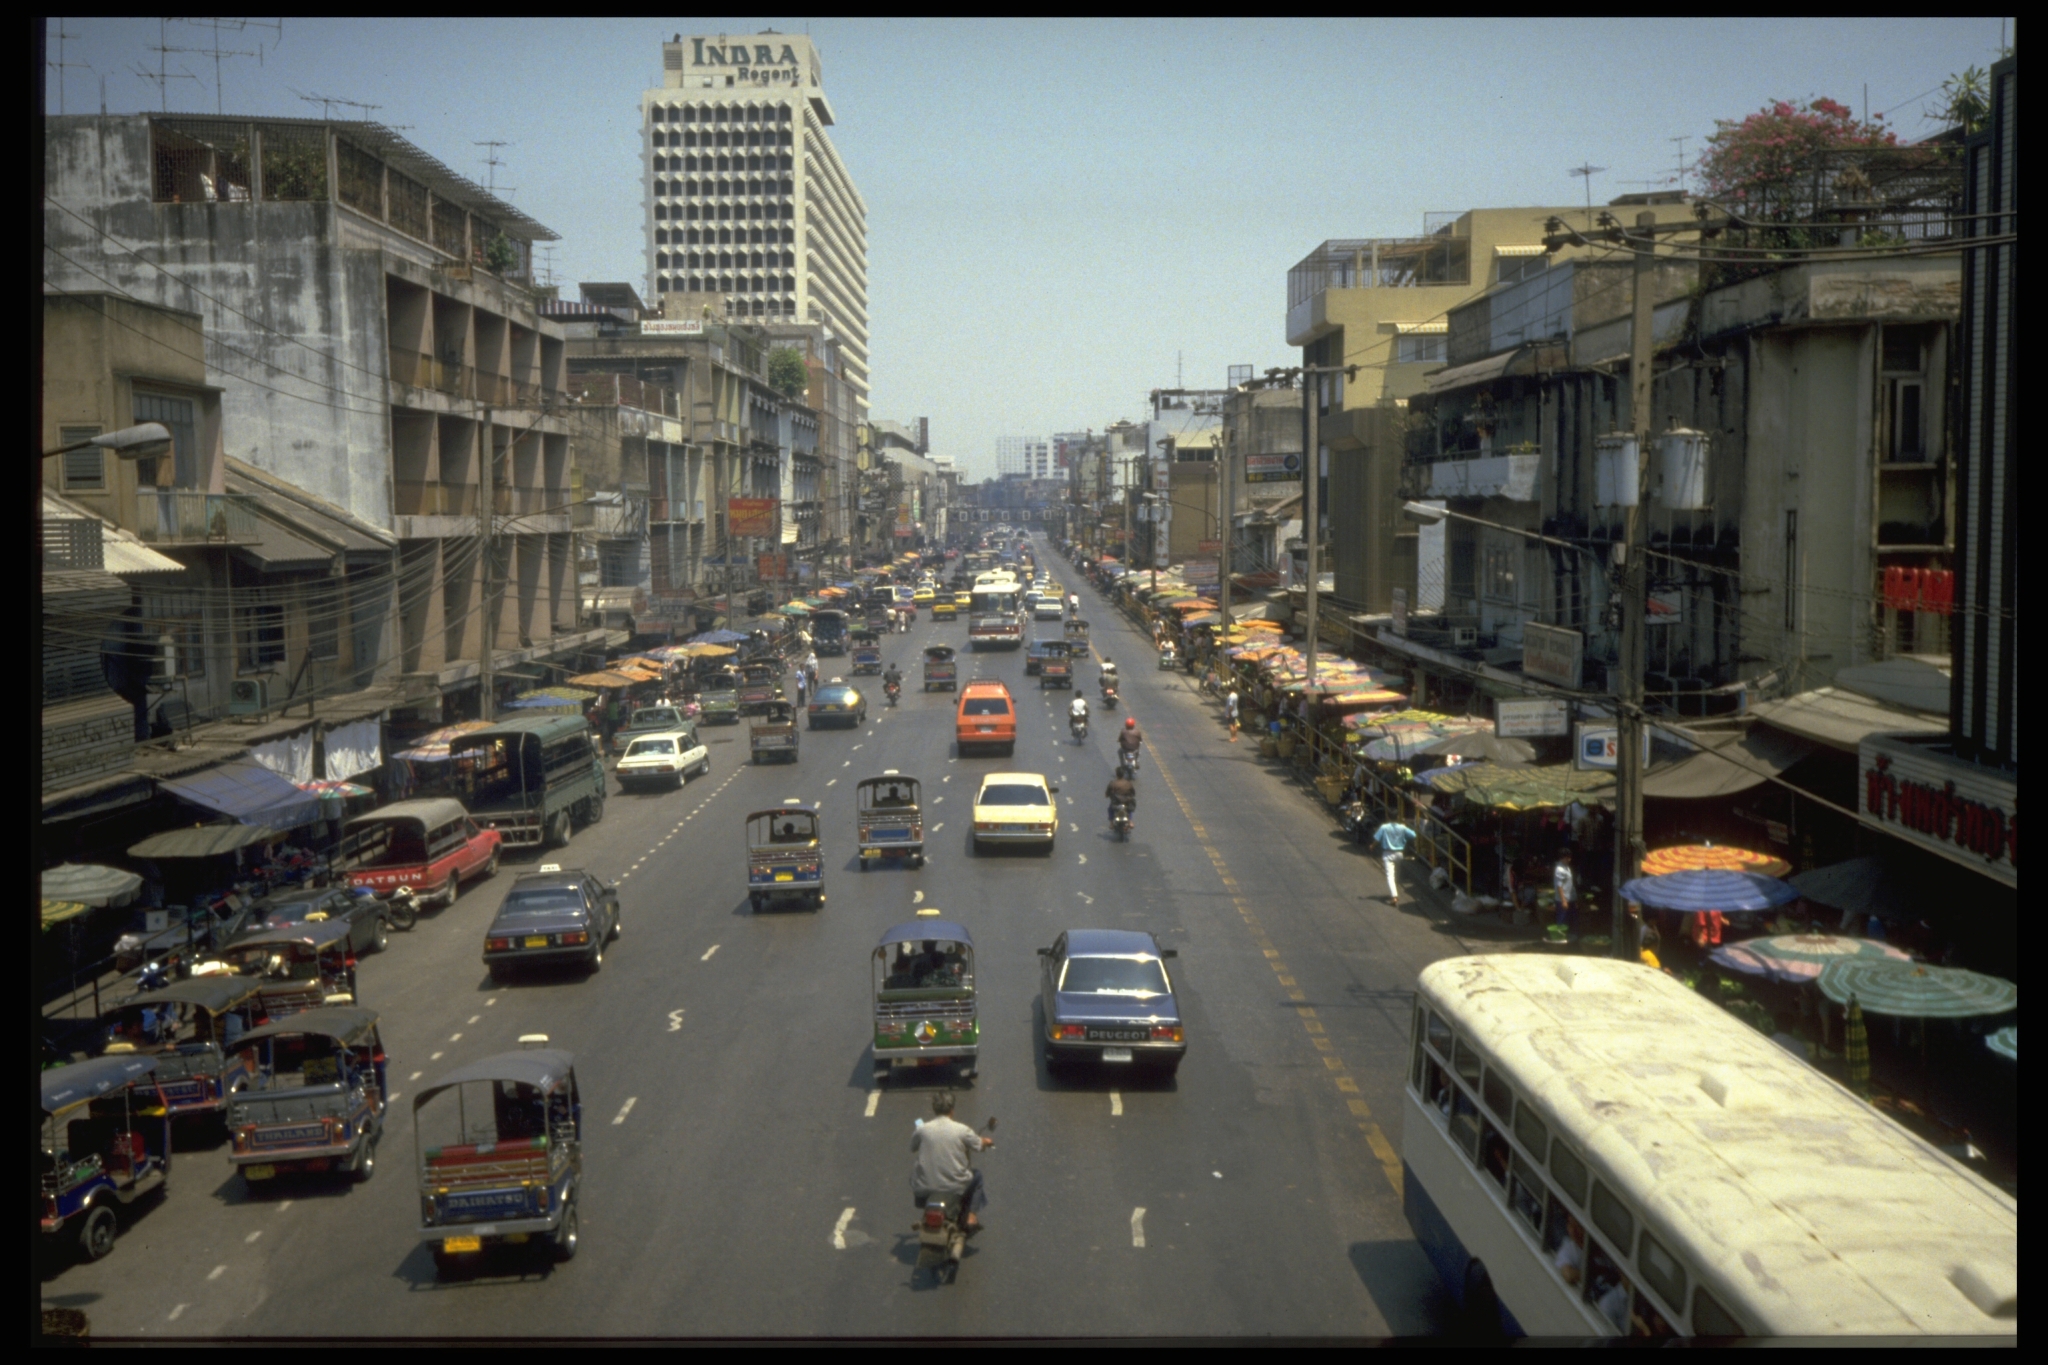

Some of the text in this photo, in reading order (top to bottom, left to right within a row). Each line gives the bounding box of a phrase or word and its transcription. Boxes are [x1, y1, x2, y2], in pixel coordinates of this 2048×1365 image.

[692, 38, 799, 66] INDRA
[737, 66, 800, 86] Regent
[353, 872, 423, 886] DATSUN
[1089, 1029, 1147, 1040] PEUGEOT
[257, 1128, 323, 1142] THAILAND
[448, 1193, 524, 1208] DAIHATSU
